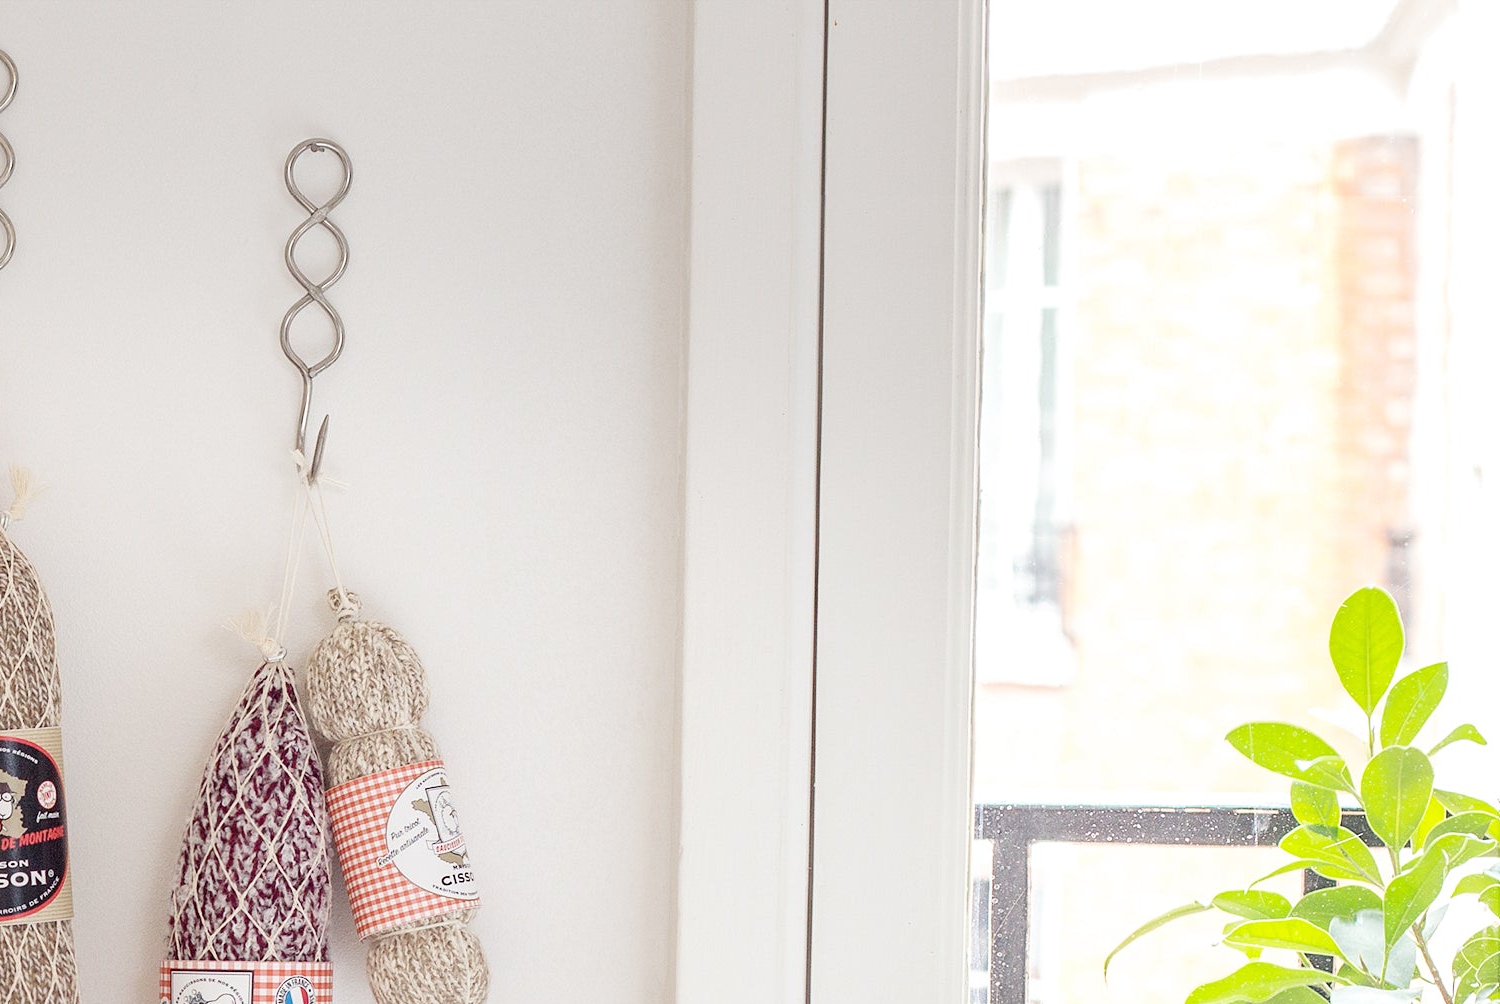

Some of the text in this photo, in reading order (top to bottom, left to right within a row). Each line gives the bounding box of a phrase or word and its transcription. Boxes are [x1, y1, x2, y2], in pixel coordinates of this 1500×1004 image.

[12, 749, 39, 765] RÉGIONS
[0, 837, 17, 851] DE
[19, 825, 65, 847] MONTAGNE
[390, 830, 404, 841] Pur
[377, 826, 430, 867] Recette artisanale
[28, 898, 40, 908] DE
[39, 875, 60, 900] FRANCE
[217, 979, 230, 988] NOS
[277, 986, 288, 1004] MADE
